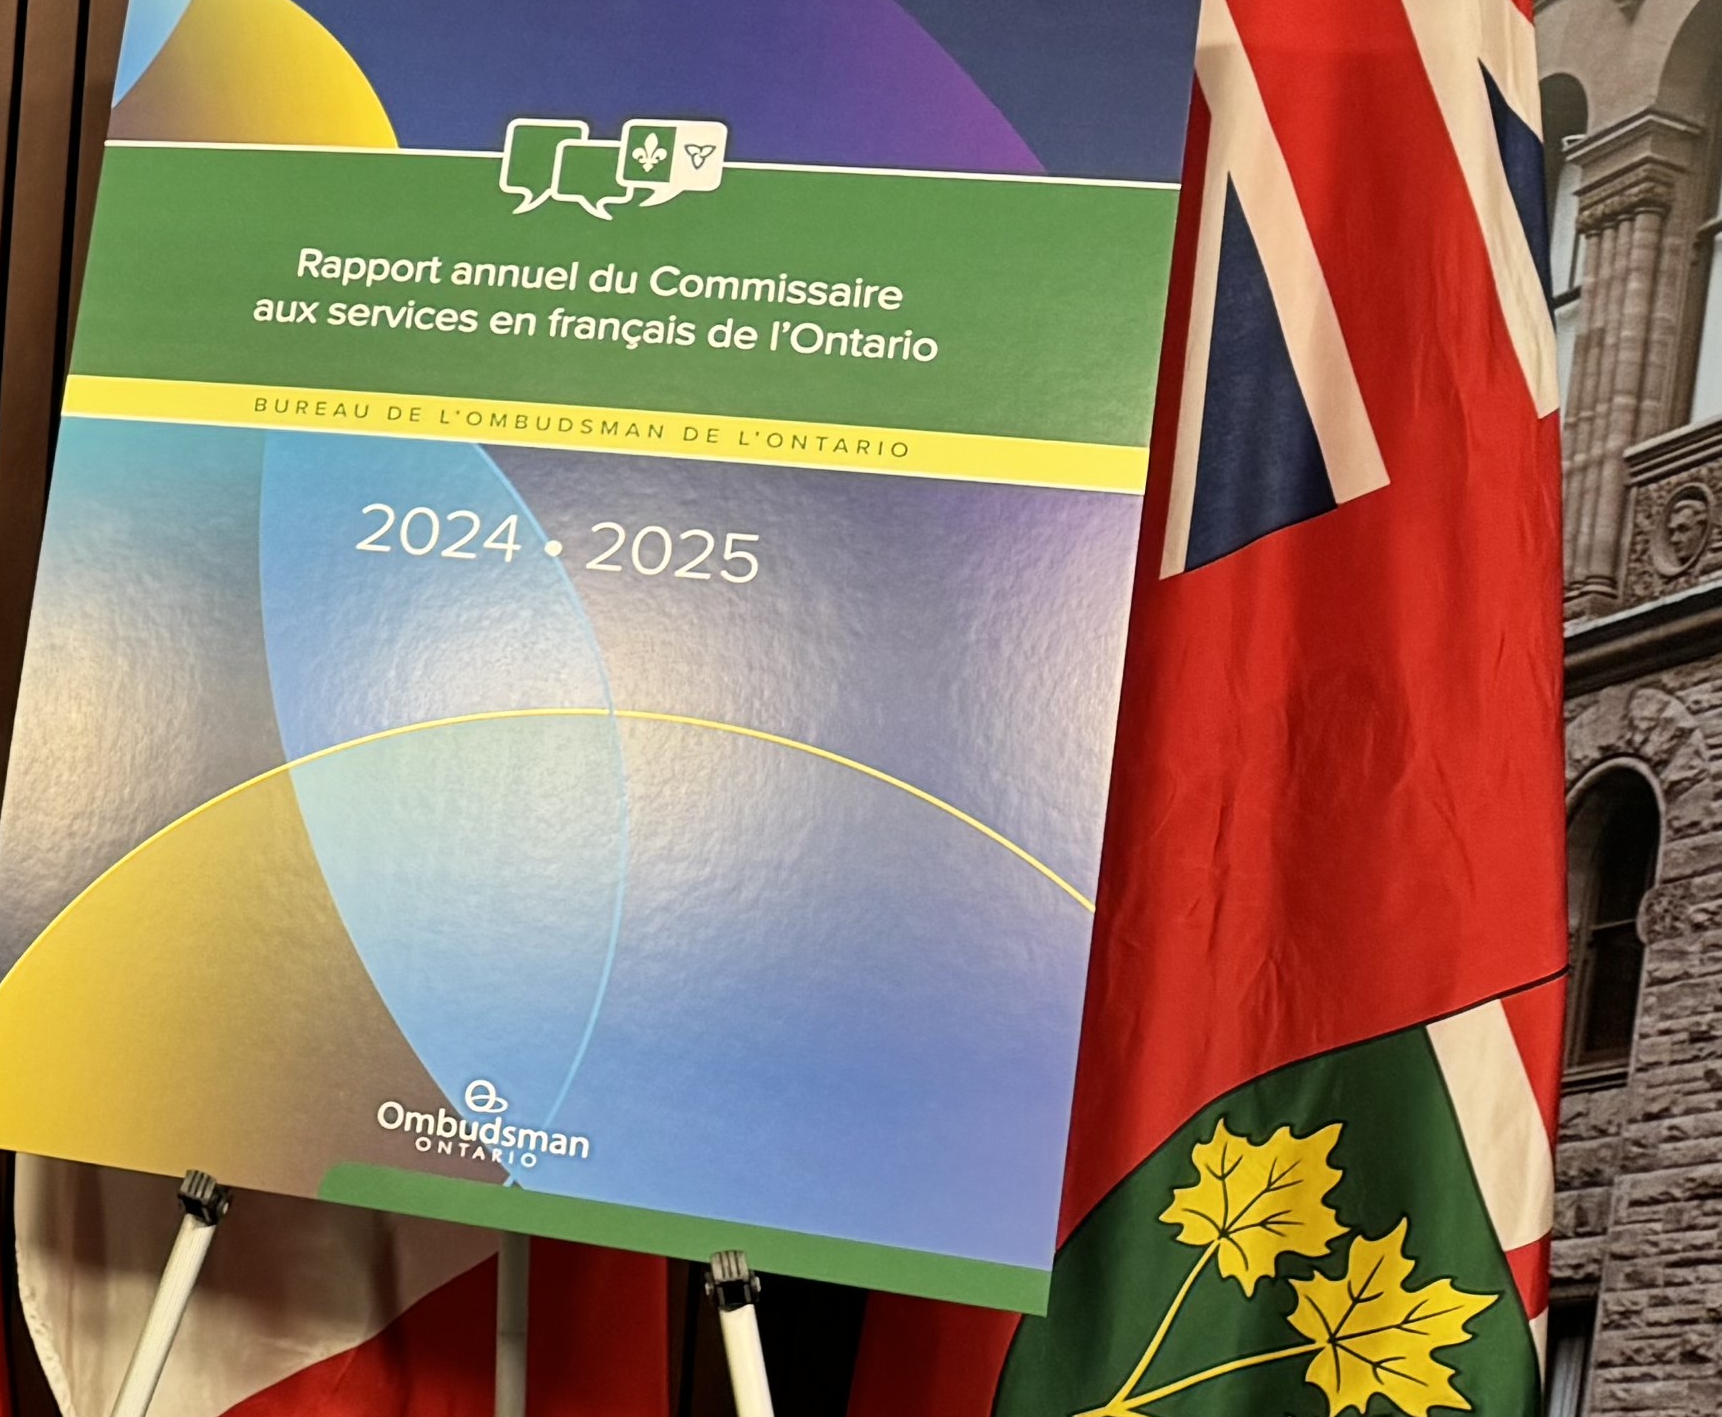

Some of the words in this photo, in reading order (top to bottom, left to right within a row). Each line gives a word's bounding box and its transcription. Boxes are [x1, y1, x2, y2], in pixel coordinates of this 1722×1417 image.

[297, 247, 443, 288] Rapport
[450, 261, 579, 291] annuel
[588, 263, 638, 294] du
[649, 265, 904, 310] Commissaire
[253, 298, 320, 324] aux
[326, 299, 479, 333] services
[489, 311, 537, 336] en
[548, 307, 696, 350] français
[707, 317, 758, 350] de
[254, 397, 371, 420] BUREAU
[386, 405, 424, 424] DE
[682, 426, 721, 445] DE
[355, 503, 522, 563] 2024
[585, 521, 760, 584] 2025
[377, 1101, 590, 1159] Ombudsman
[415, 1137, 537, 1168] ONTARIO
